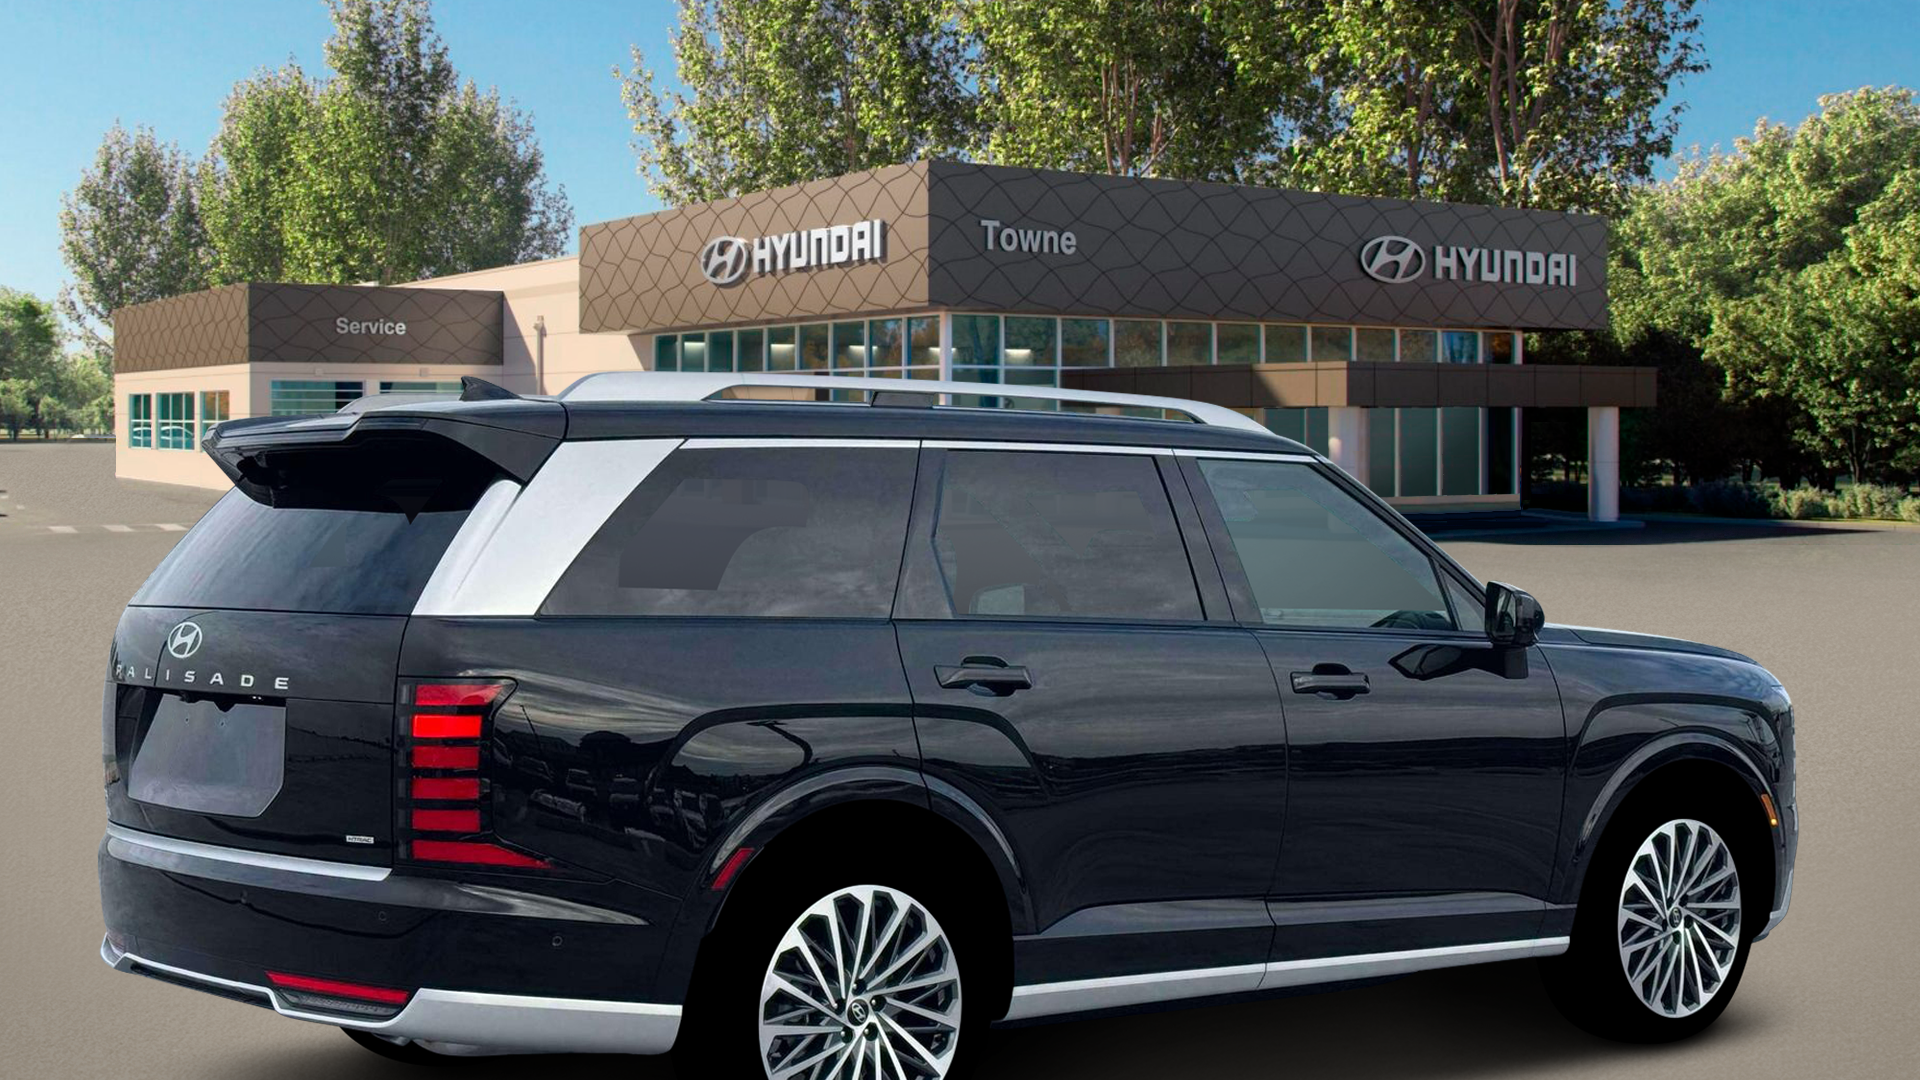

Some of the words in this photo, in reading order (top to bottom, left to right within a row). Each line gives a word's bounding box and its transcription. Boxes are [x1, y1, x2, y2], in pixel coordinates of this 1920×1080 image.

[753, 219, 882, 274] HYUNDAI
[980, 220, 1077, 255] Towne
[1435, 246, 1577, 286] HYUNDAI
[335, 317, 407, 335] Service
[116, 664, 290, 690] PALISADE
